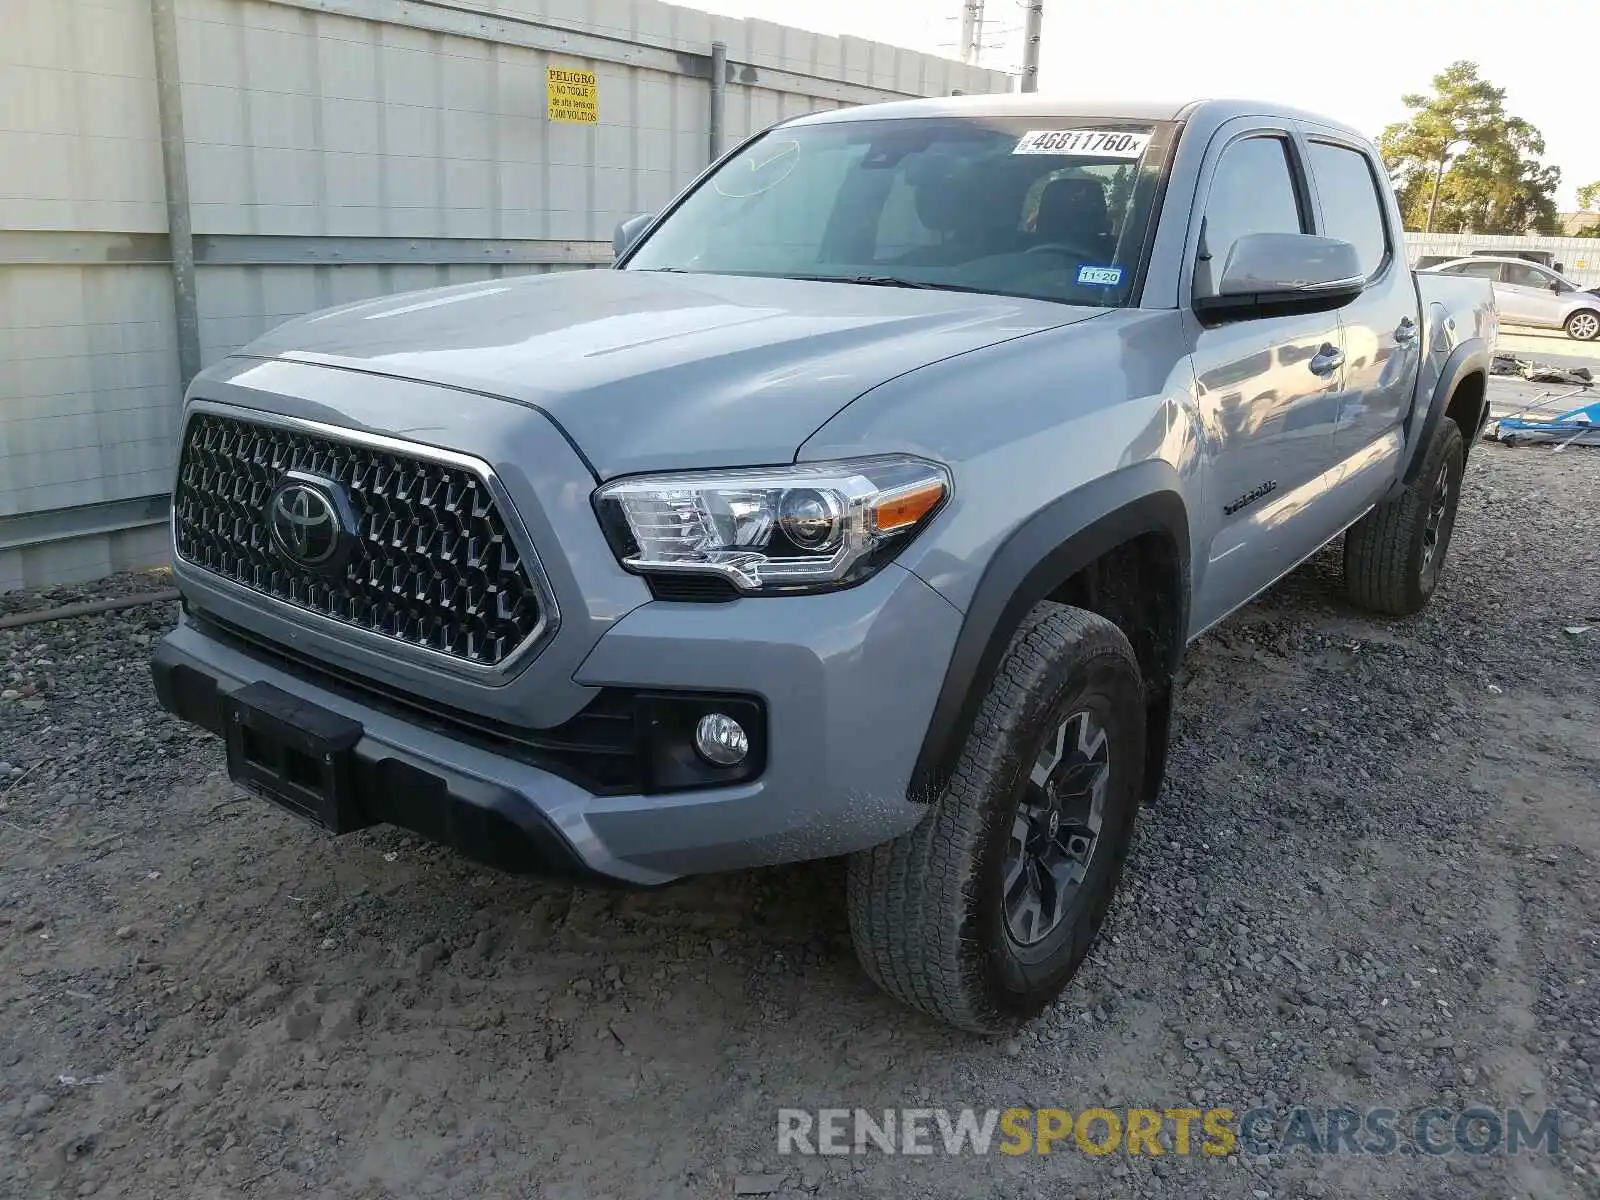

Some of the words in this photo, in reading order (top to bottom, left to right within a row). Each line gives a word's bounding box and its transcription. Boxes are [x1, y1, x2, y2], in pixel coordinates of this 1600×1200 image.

[549, 69, 595, 84] PELIGRO
[556, 85, 566, 95] NO
[567, 86, 589, 97] TOQUE
